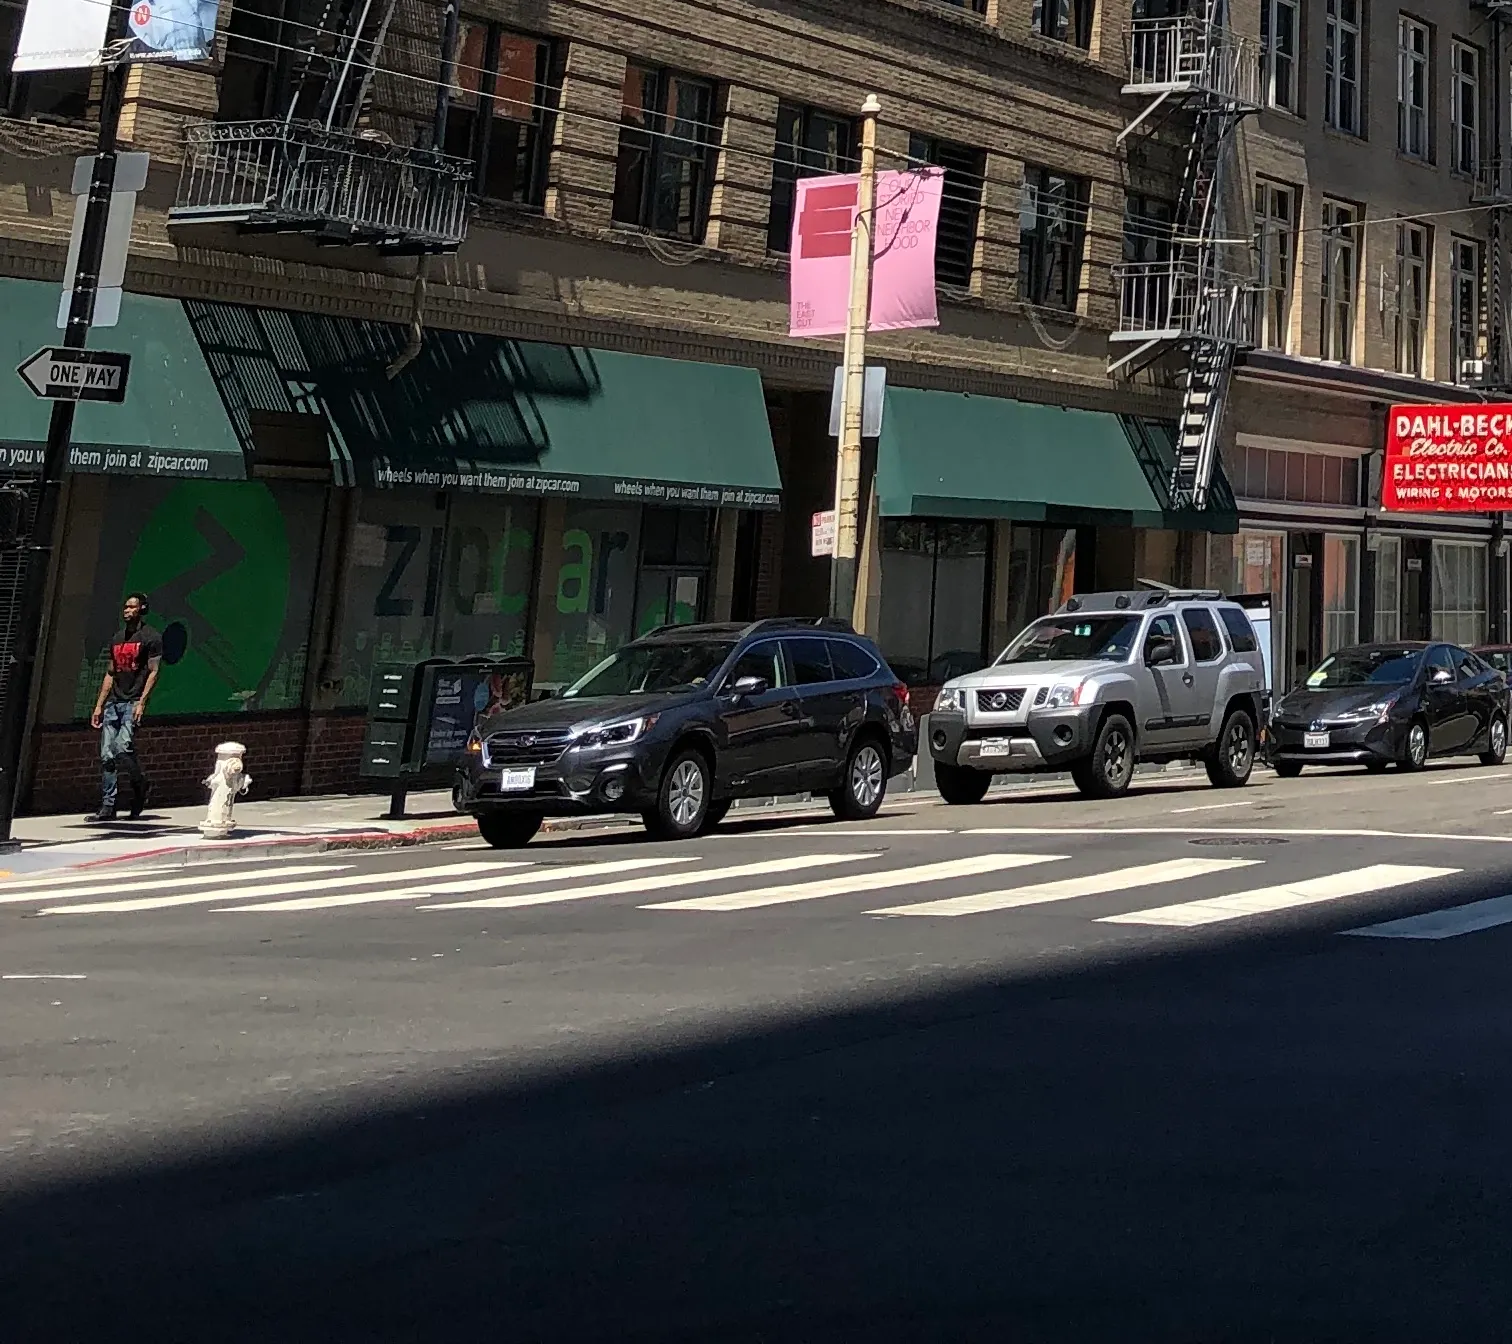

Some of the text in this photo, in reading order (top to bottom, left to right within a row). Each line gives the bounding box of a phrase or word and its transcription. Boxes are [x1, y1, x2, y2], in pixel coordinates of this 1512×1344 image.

[796, 301, 811, 310] THE
[796, 310, 815, 319] EAST
[796, 318, 812, 327] CUT
[51, 364, 117, 387] ONE WAY
[1409, 437, 1508, 457] Electric Co.
[10, 449, 33, 467] you
[70, 447, 101, 465] them
[103, 450, 127, 470] join
[130, 452, 142, 467] at
[147, 453, 209, 473] zipcar.com
[377, 466, 580, 494] wheels when you want them join at zipcar.com
[614, 480, 780, 506] wheels when you want them join at zipcar.com
[1395, 486, 1440, 500] WIRING
[1445, 486, 1453, 499] &
